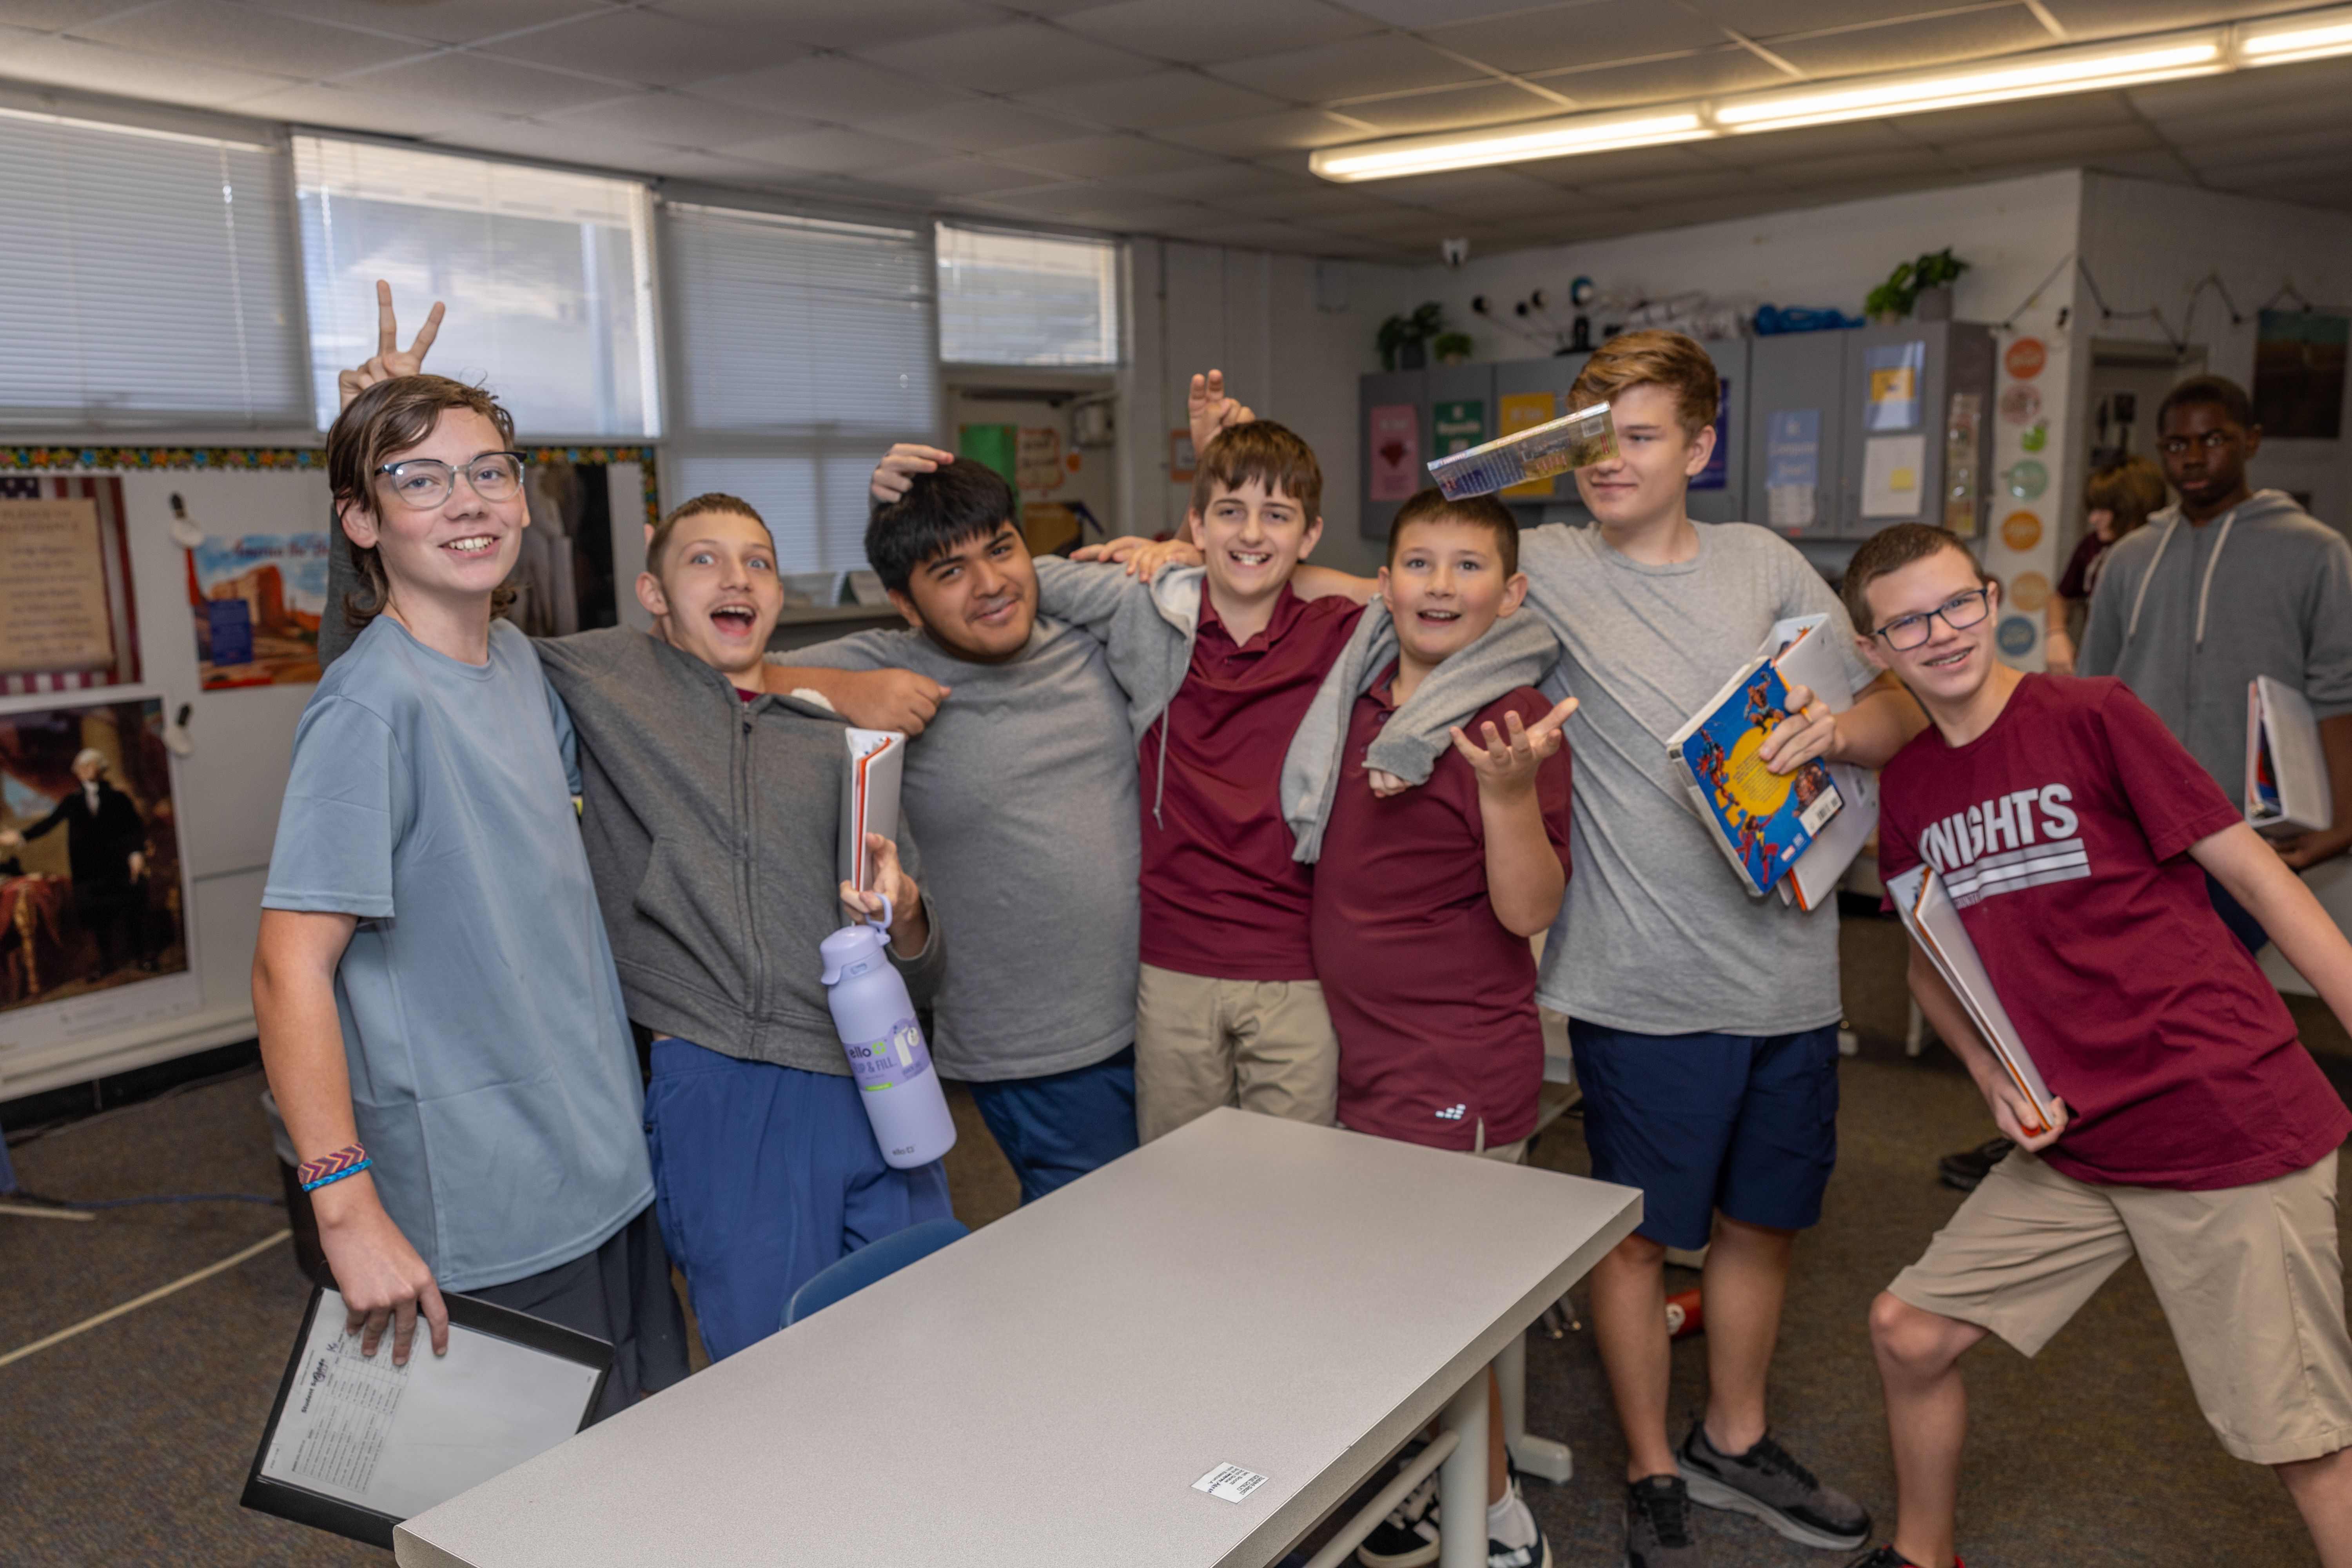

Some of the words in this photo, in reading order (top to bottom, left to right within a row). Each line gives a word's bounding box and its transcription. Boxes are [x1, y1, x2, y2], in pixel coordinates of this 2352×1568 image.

[849, 1046, 871, 1058] ello
[867, 1061, 875, 1073] &
[876, 1056, 894, 1071] FILL
